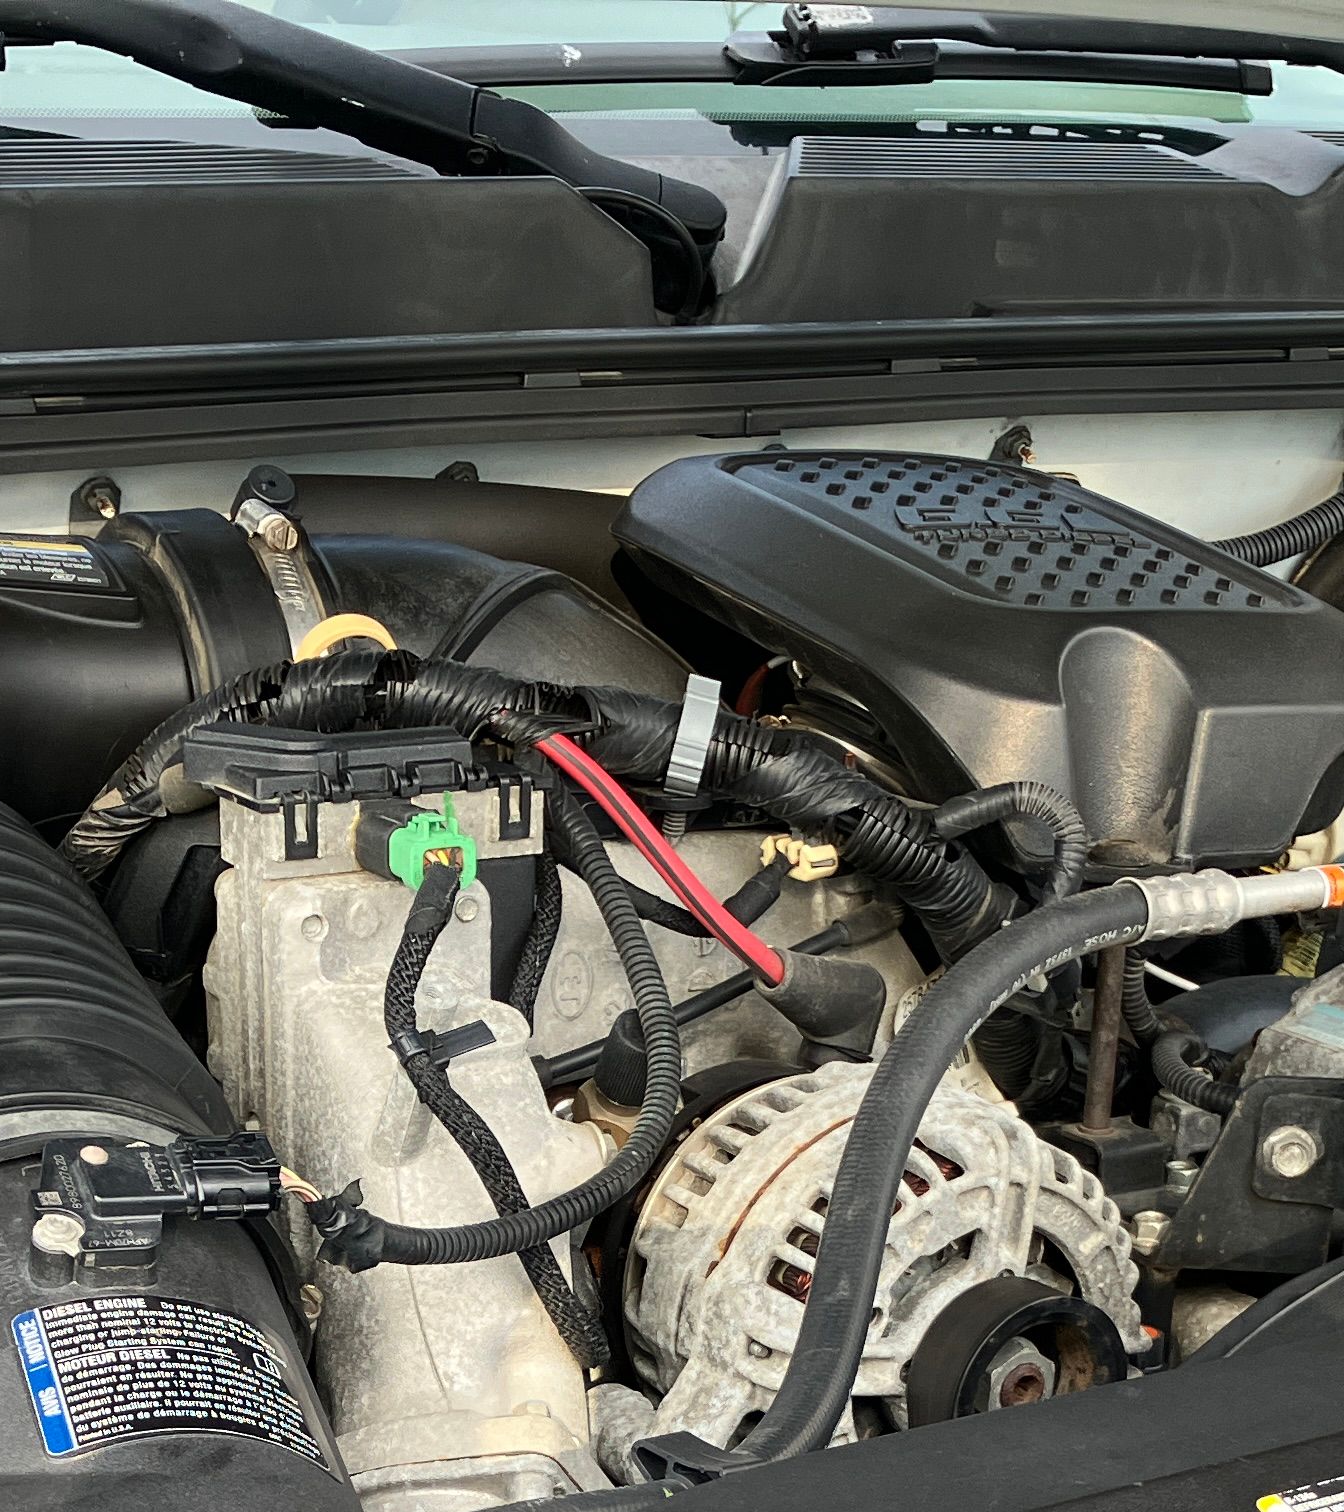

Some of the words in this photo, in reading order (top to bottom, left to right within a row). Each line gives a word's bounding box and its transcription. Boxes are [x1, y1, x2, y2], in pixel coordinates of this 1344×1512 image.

[1084, 930, 1118, 949] HOSE
[42, 1301, 93, 1321] DIESEL
[93, 1298, 147, 1310] ENGINE
[160, 1301, 175, 1310] Do
[45, 1312, 99, 1330] Immediate
[100, 1309, 134, 1319] engine
[137, 1308, 176, 1319] damage
[178, 1313, 196, 1321] can
[48, 1327, 74, 1339] more
[76, 1320, 99, 1334] than
[101, 1317, 140, 1329] nominal
[143, 1317, 157, 1326] 12
[159, 1319, 182, 1328] volts
[183, 1320, 194, 1329] to
[50, 1332, 96, 1349] charging
[97, 1329, 109, 1339] or
[183, 1329, 215, 1342] Failure
[18, 1318, 48, 1365] NOTICE
[54, 1346, 80, 1360] Glow
[81, 1341, 105, 1355] Plug
[106, 1336, 148, 1348] Starting
[149, 1335, 186, 1348] System
[188, 1341, 206, 1349] can
[57, 1351, 118, 1375] MOTEUR
[119, 1348, 172, 1363] DIESEL
[60, 1373, 75, 1383] de
[137, 1361, 157, 1370] Des
[160, 1361, 213, 1374] dommages
[63, 1373, 118, 1395] pourraient
[119, 1372, 133, 1382] en
[66, 1383, 114, 1403] nominale
[115, 1382, 130, 1392] de
[132, 1380, 155, 1391] plus
[156, 1380, 171, 1389] de
[172, 1380, 187, 1389] 12
[188, 1380, 213, 1390] volts
[38, 1386, 62, 1418] AVIS
[69, 1395, 113, 1415] pendant
[126, 1390, 163, 1402] charge
[72, 1405, 113, 1424] batterie
[75, 1423, 90, 1433] du
[90, 1413, 135, 1429] système
[136, 1410, 152, 1420] de
[153, 1408, 210, 1420] démarrage
